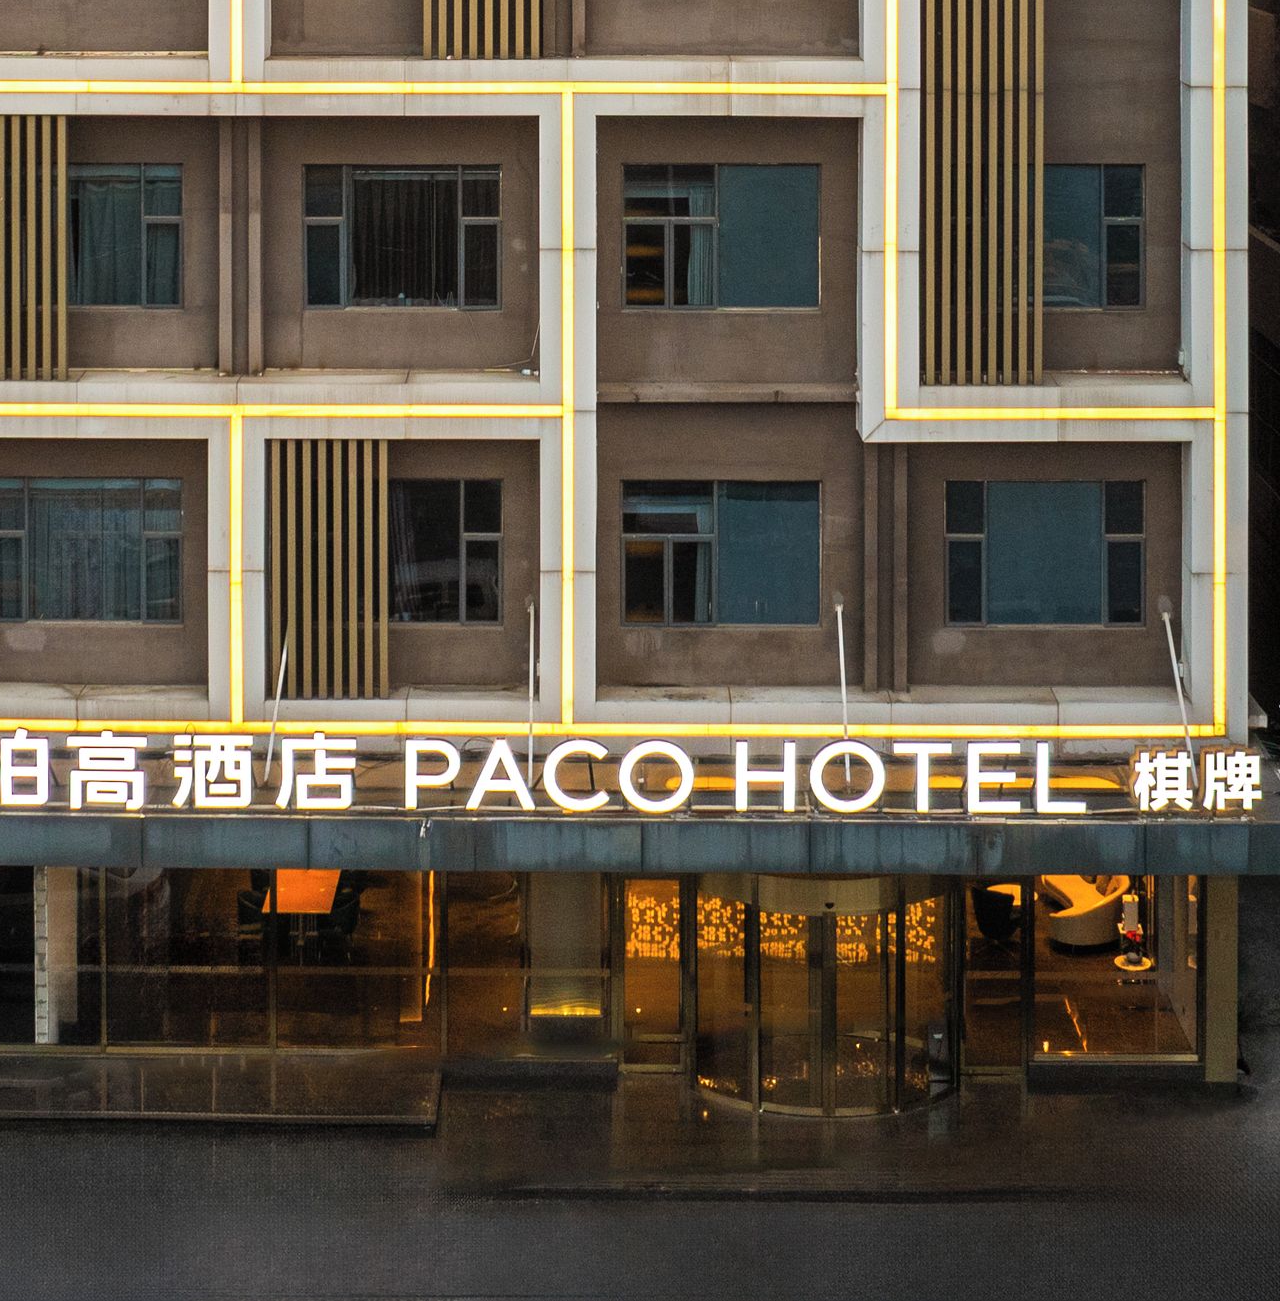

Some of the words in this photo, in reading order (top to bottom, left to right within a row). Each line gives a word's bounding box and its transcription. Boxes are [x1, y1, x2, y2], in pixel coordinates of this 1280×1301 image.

[404, 736, 695, 813] PACO
[733, 739, 1087, 814] HOTEL
[1131, 748, 1264, 813] 棋牌
